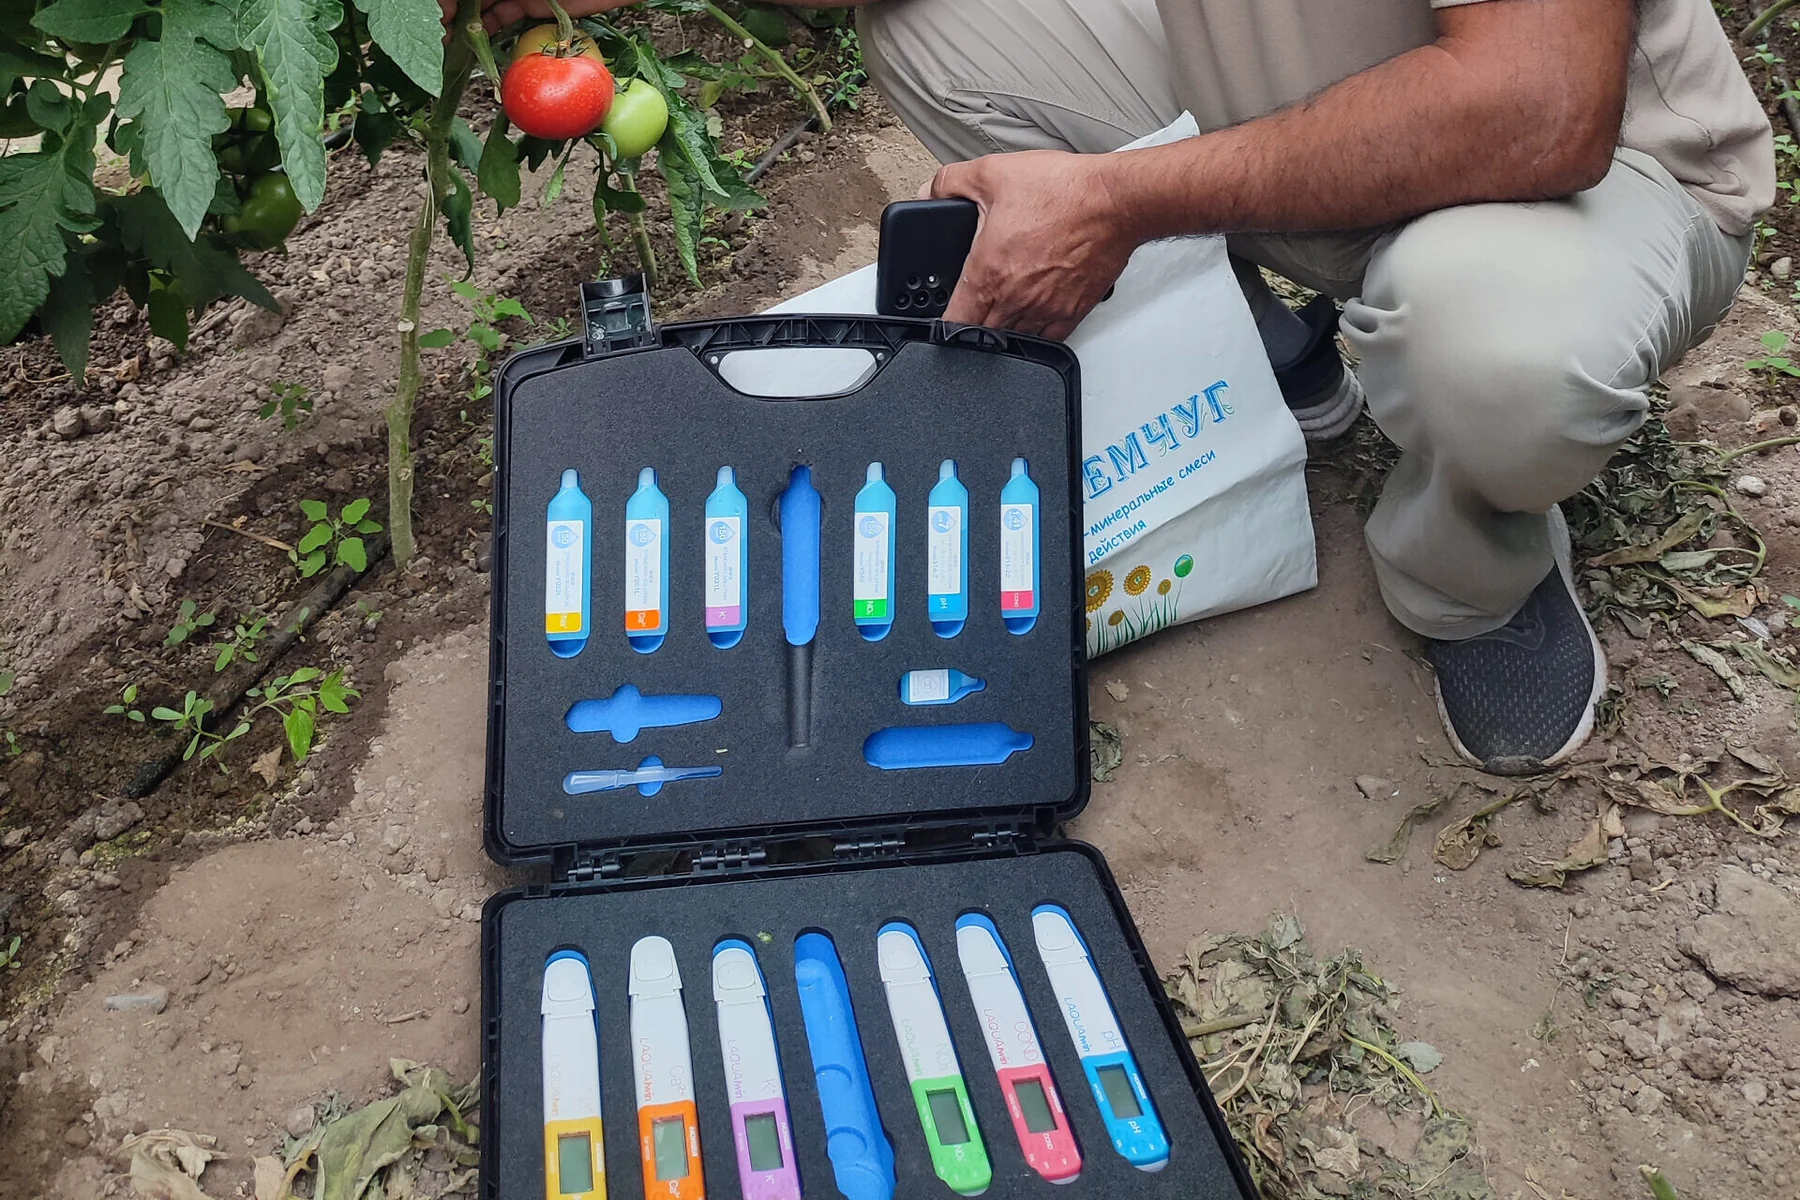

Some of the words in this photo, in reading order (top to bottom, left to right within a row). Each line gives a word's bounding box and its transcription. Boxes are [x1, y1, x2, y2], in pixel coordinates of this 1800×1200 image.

[1254, 167, 1334, 197] GANT
[1083, 379, 1230, 500] ЕМЧУГ
[1178, 449, 1217, 479] смеси
[639, 528, 647, 543] 150
[718, 525, 727, 540] 150
[1087, 519, 1148, 565] действия
[939, 597, 947, 609] pH
[983, 1008, 1009, 1065] LAQUAtwin
[1013, 1020, 1039, 1062] COND
[1063, 997, 1091, 1053] LAQUAtwin
[1100, 1030, 1120, 1051] pH
[639, 1036, 652, 1101] LAQUAtwin
[727, 1039, 743, 1099] LAQUAtwin
[1127, 1120, 1142, 1134] pH
